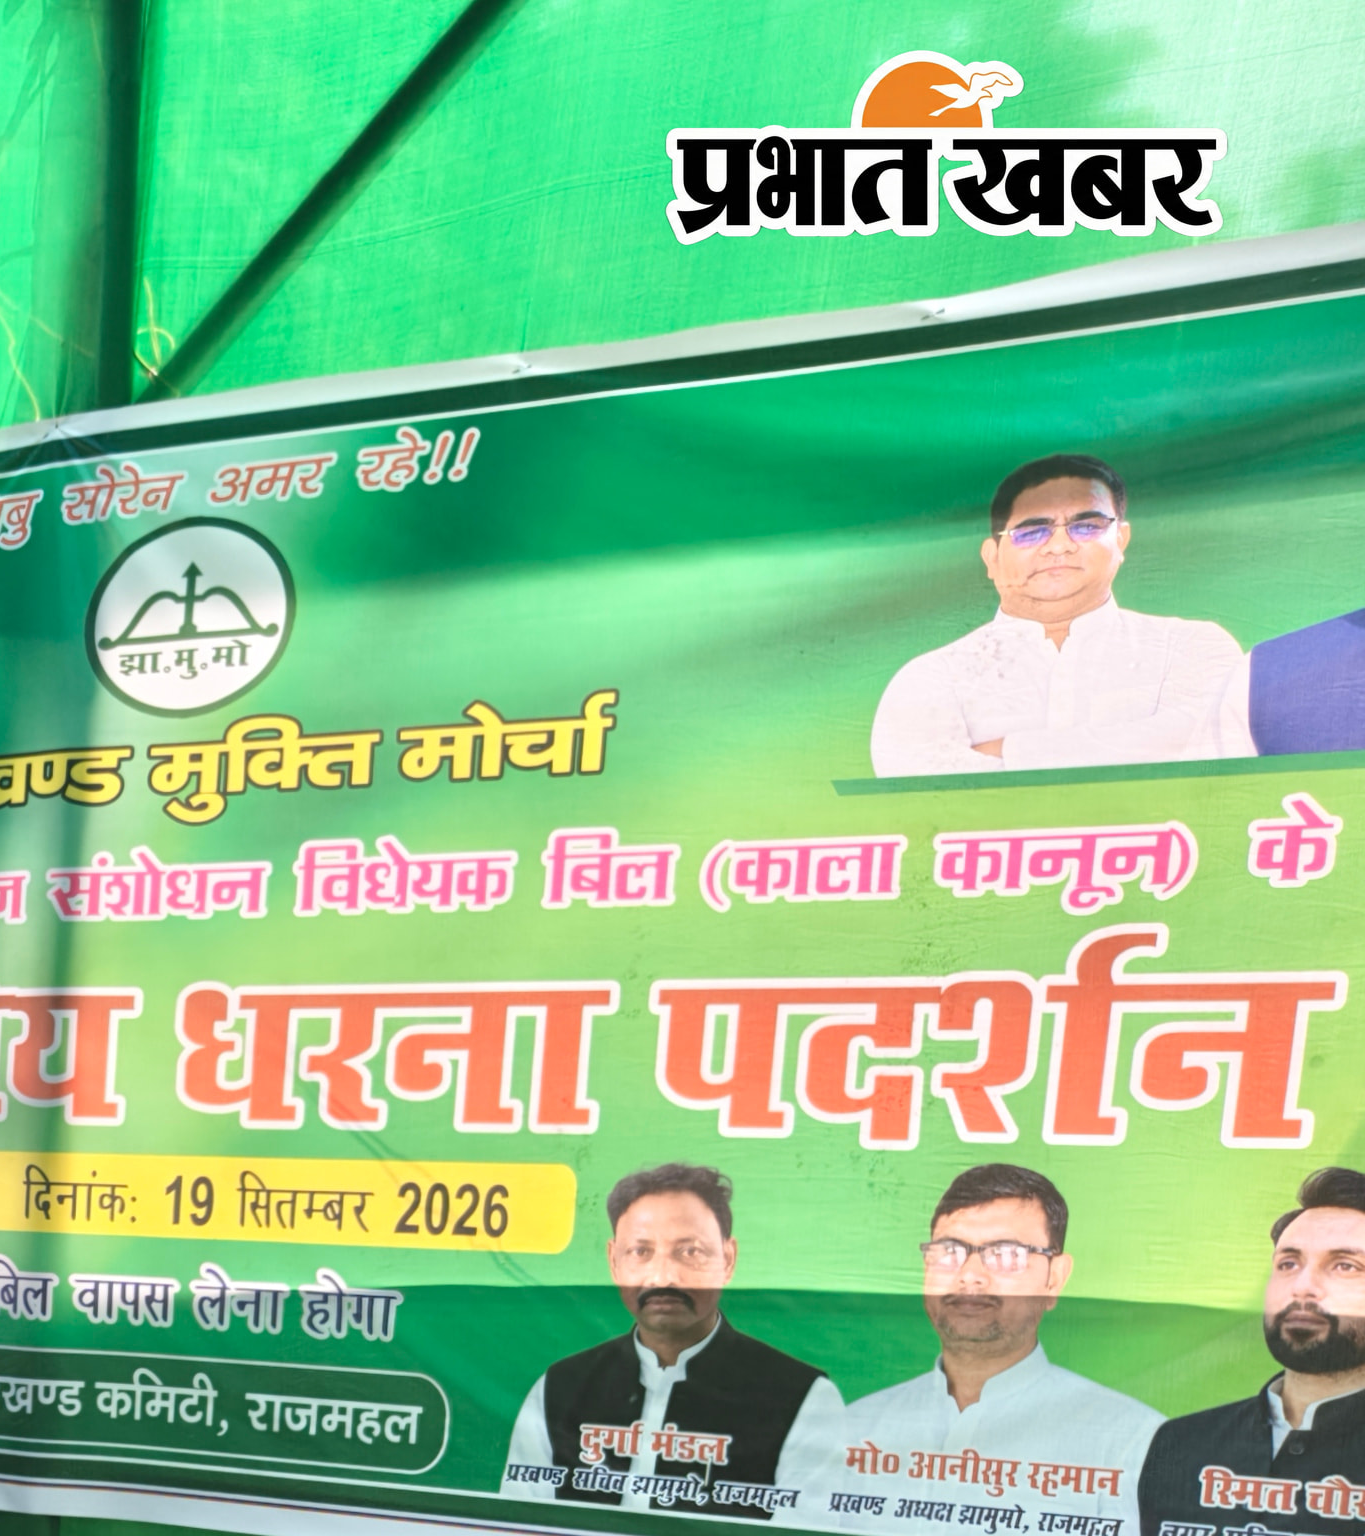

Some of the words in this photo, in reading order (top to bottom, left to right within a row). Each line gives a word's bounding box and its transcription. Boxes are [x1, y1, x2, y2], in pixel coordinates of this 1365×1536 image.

[62, 464, 185, 528] सोरेन
[208, 453, 338, 508] अमर
[355, 427, 482, 493] रहे!!
[148, 715, 382, 827] मुक्ति
[399, 689, 620, 783] मोर्चा
[46, 843, 272, 922] संशोधन
[293, 836, 517, 917] विधेयक
[541, 826, 680, 907] बिल
[699, 833, 909, 913] (काला
[933, 819, 1199, 917] कानून)
[1248, 791, 1343, 889] के
[174, 978, 620, 1135] धरना
[648, 922, 1349, 1151] पदर्शन
[21, 1163, 140, 1224] दिनांक:
[163, 1176, 215, 1226] 19
[238, 1170, 375, 1234] सितम्बर
[394, 1181, 511, 1238] 2026
[68, 1271, 178, 1331] वापस
[191, 1261, 289, 1338] लेना
[299, 1266, 405, 1344] होगा
[95, 1366, 231, 1439] कमिटी,
[246, 1390, 424, 1447] राजमहल
[580, 1423, 643, 1464] दुर्गा
[651, 1425, 732, 1466] मंडल
[504, 1463, 568, 1488] प्रखण्ड
[572, 1466, 628, 1495] सचिव
[630, 1473, 710, 1507] झामुमो,
[712, 1481, 801, 1512] राजमहल
[828, 1490, 886, 1517] प्रखण्ड
[893, 1497, 954, 1524] अध्यक्ष
[957, 1501, 1030, 1536] झामुमो,
[909, 1448, 1022, 1498] आनीसुर
[1026, 1461, 1126, 1499] रहमान
